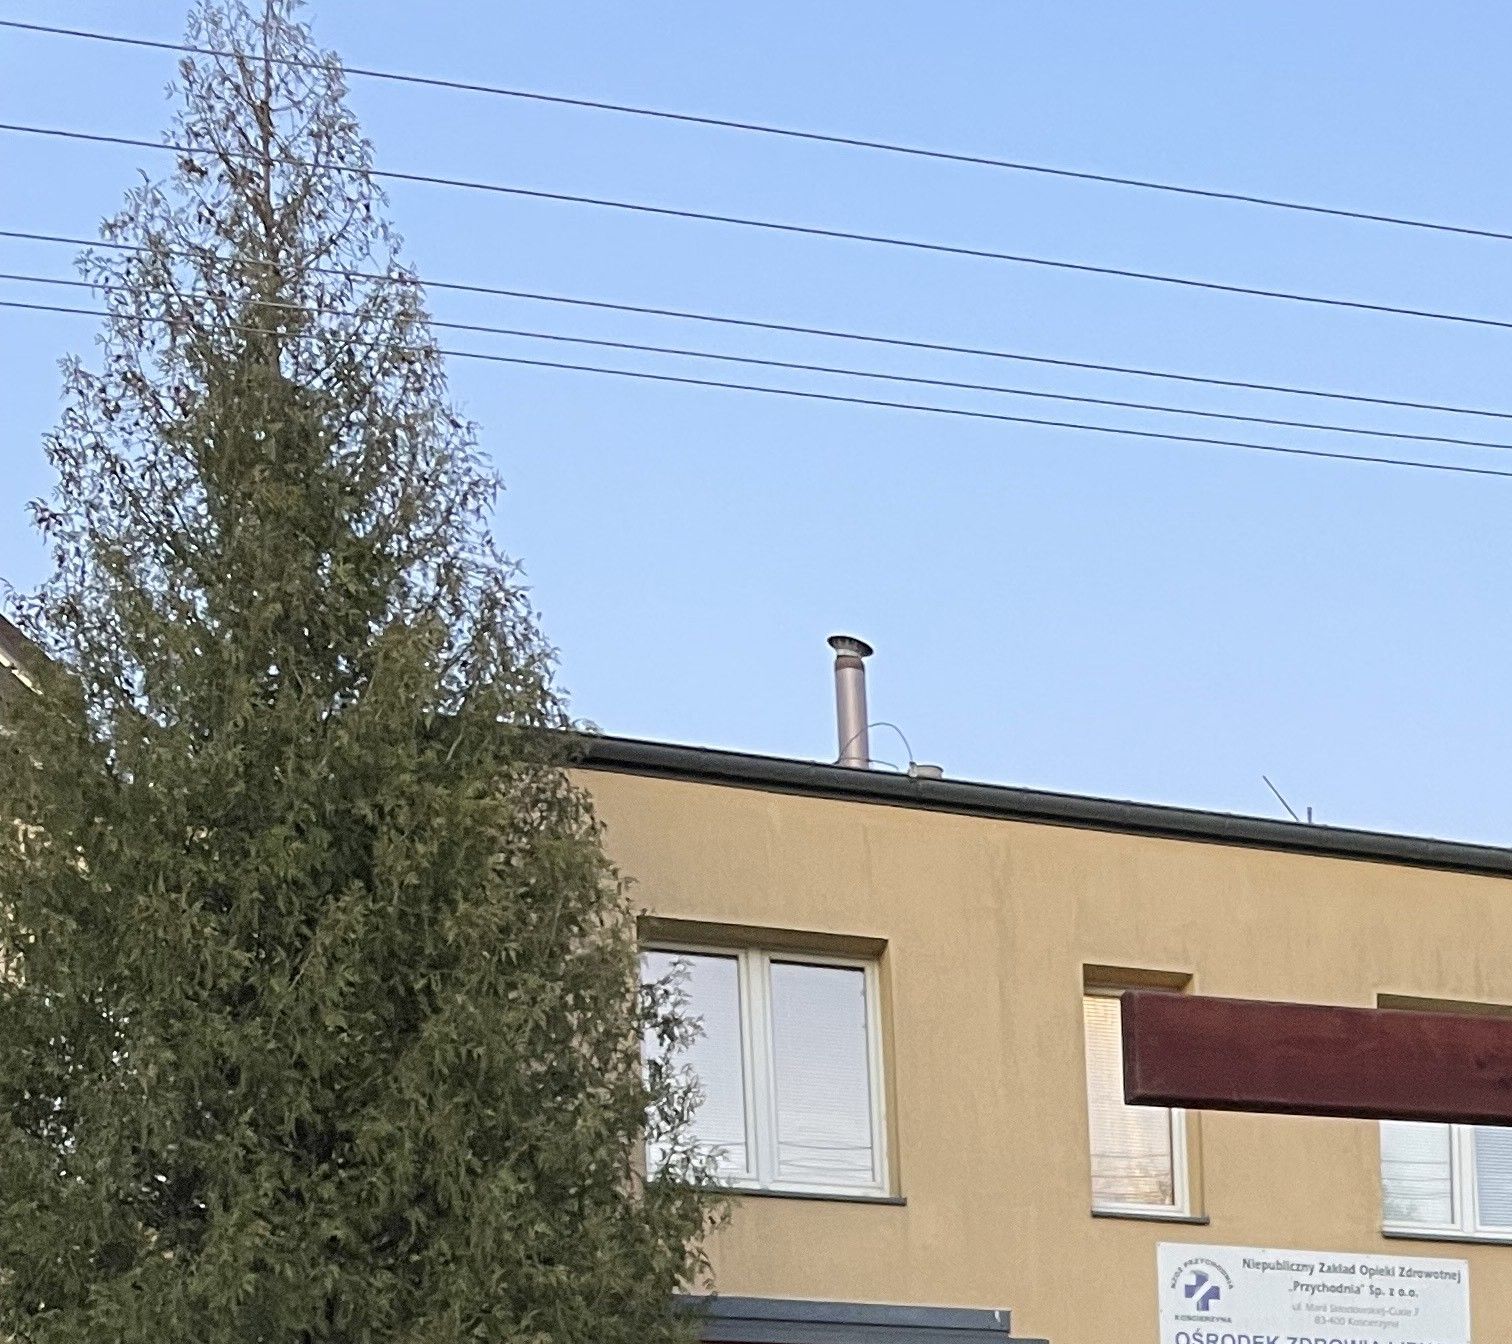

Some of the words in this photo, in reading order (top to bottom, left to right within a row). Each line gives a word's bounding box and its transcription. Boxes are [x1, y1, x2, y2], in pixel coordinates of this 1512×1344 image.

[1242, 1258, 1315, 1276] Niepubliczny
[1318, 1262, 1356, 1275] Zakład
[1359, 1264, 1396, 1280] Opieki
[1398, 1266, 1462, 1285] Zdrowotnej
[1368, 1284, 1386, 1299] Sp.
[1388, 1287, 1395, 1297] z
[1398, 1288, 1419, 1298] o.o.
